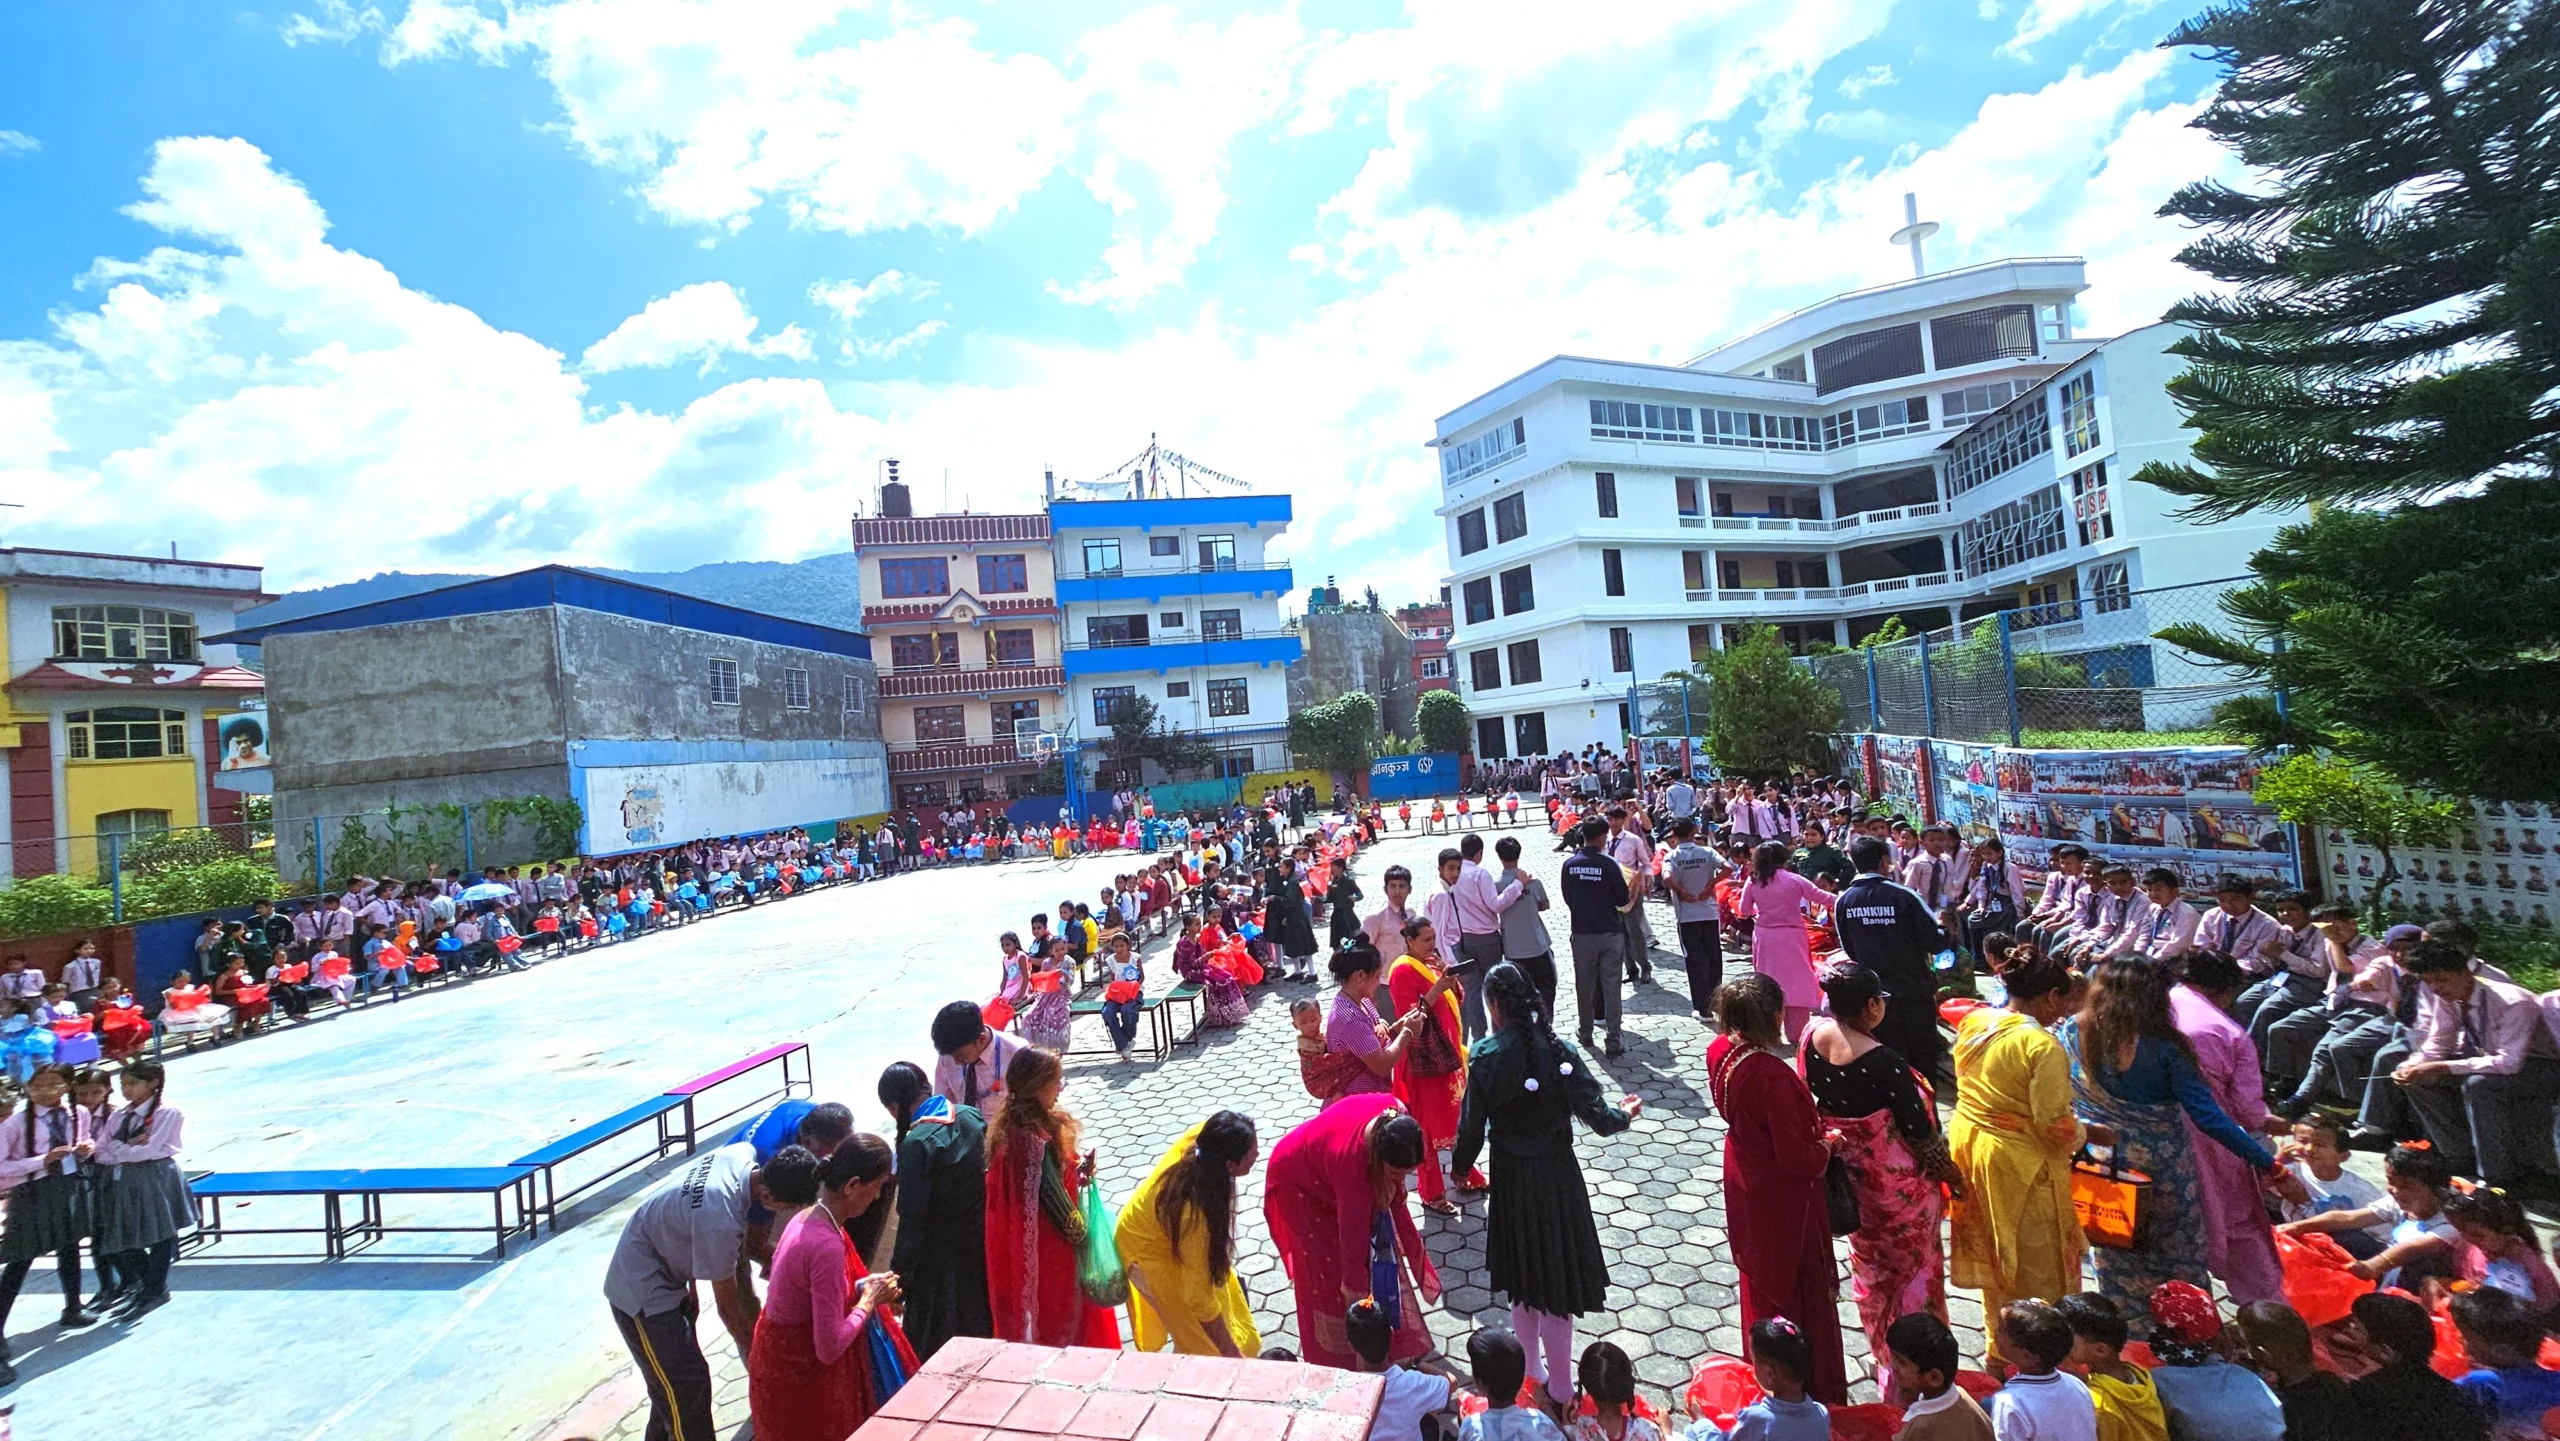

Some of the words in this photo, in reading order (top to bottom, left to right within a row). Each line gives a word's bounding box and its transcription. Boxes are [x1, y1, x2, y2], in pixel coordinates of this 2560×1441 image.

[1417, 756, 1434, 774] GSP
[1569, 866, 1602, 876] GYANKUNJ
[1846, 905, 1895, 919] GYANKUNJ
[1862, 917, 1896, 926] Banepa
[691, 1153, 715, 1210] GYANKUNJ
